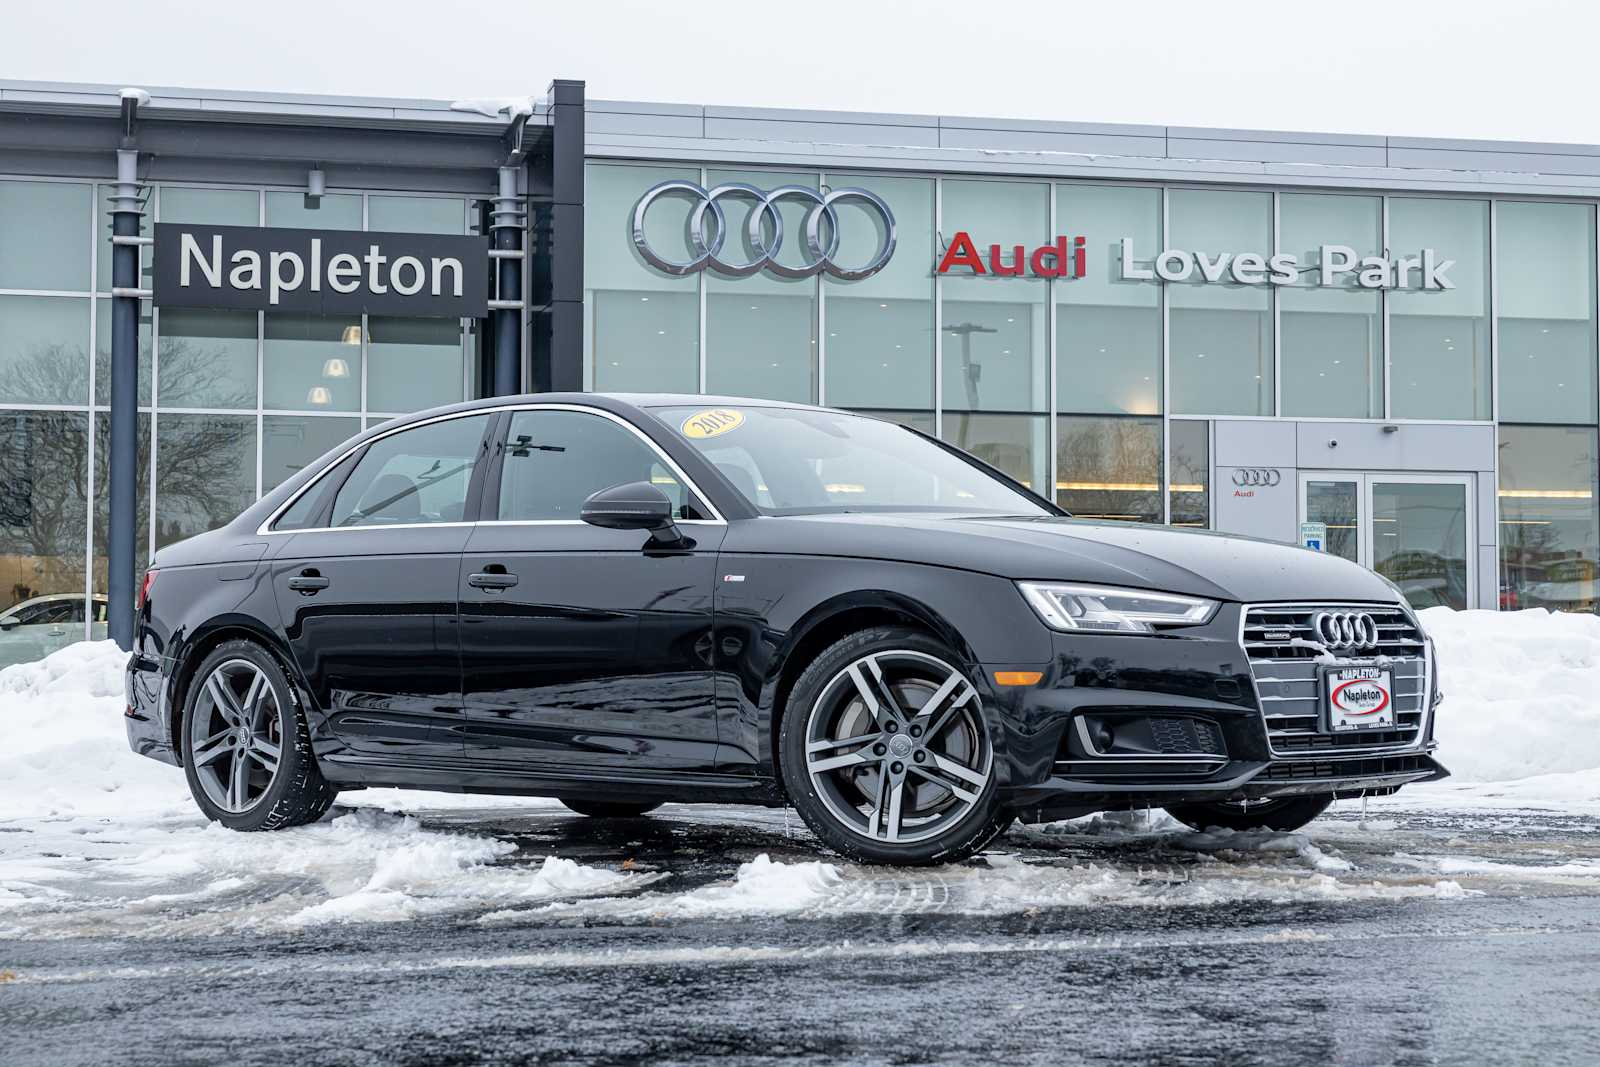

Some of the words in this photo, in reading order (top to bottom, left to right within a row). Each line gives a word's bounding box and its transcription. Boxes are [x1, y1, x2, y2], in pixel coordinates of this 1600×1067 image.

[180, 232, 464, 305] Napleton
[938, 231, 1087, 278] Audi
[1121, 238, 1299, 286] Loves
[1319, 244, 1457, 290] Park
[692, 411, 736, 434] 2018
[1234, 489, 1254, 497] Audi
[1342, 668, 1379, 679] NAPLETON
[1343, 688, 1381, 704] Napleton
